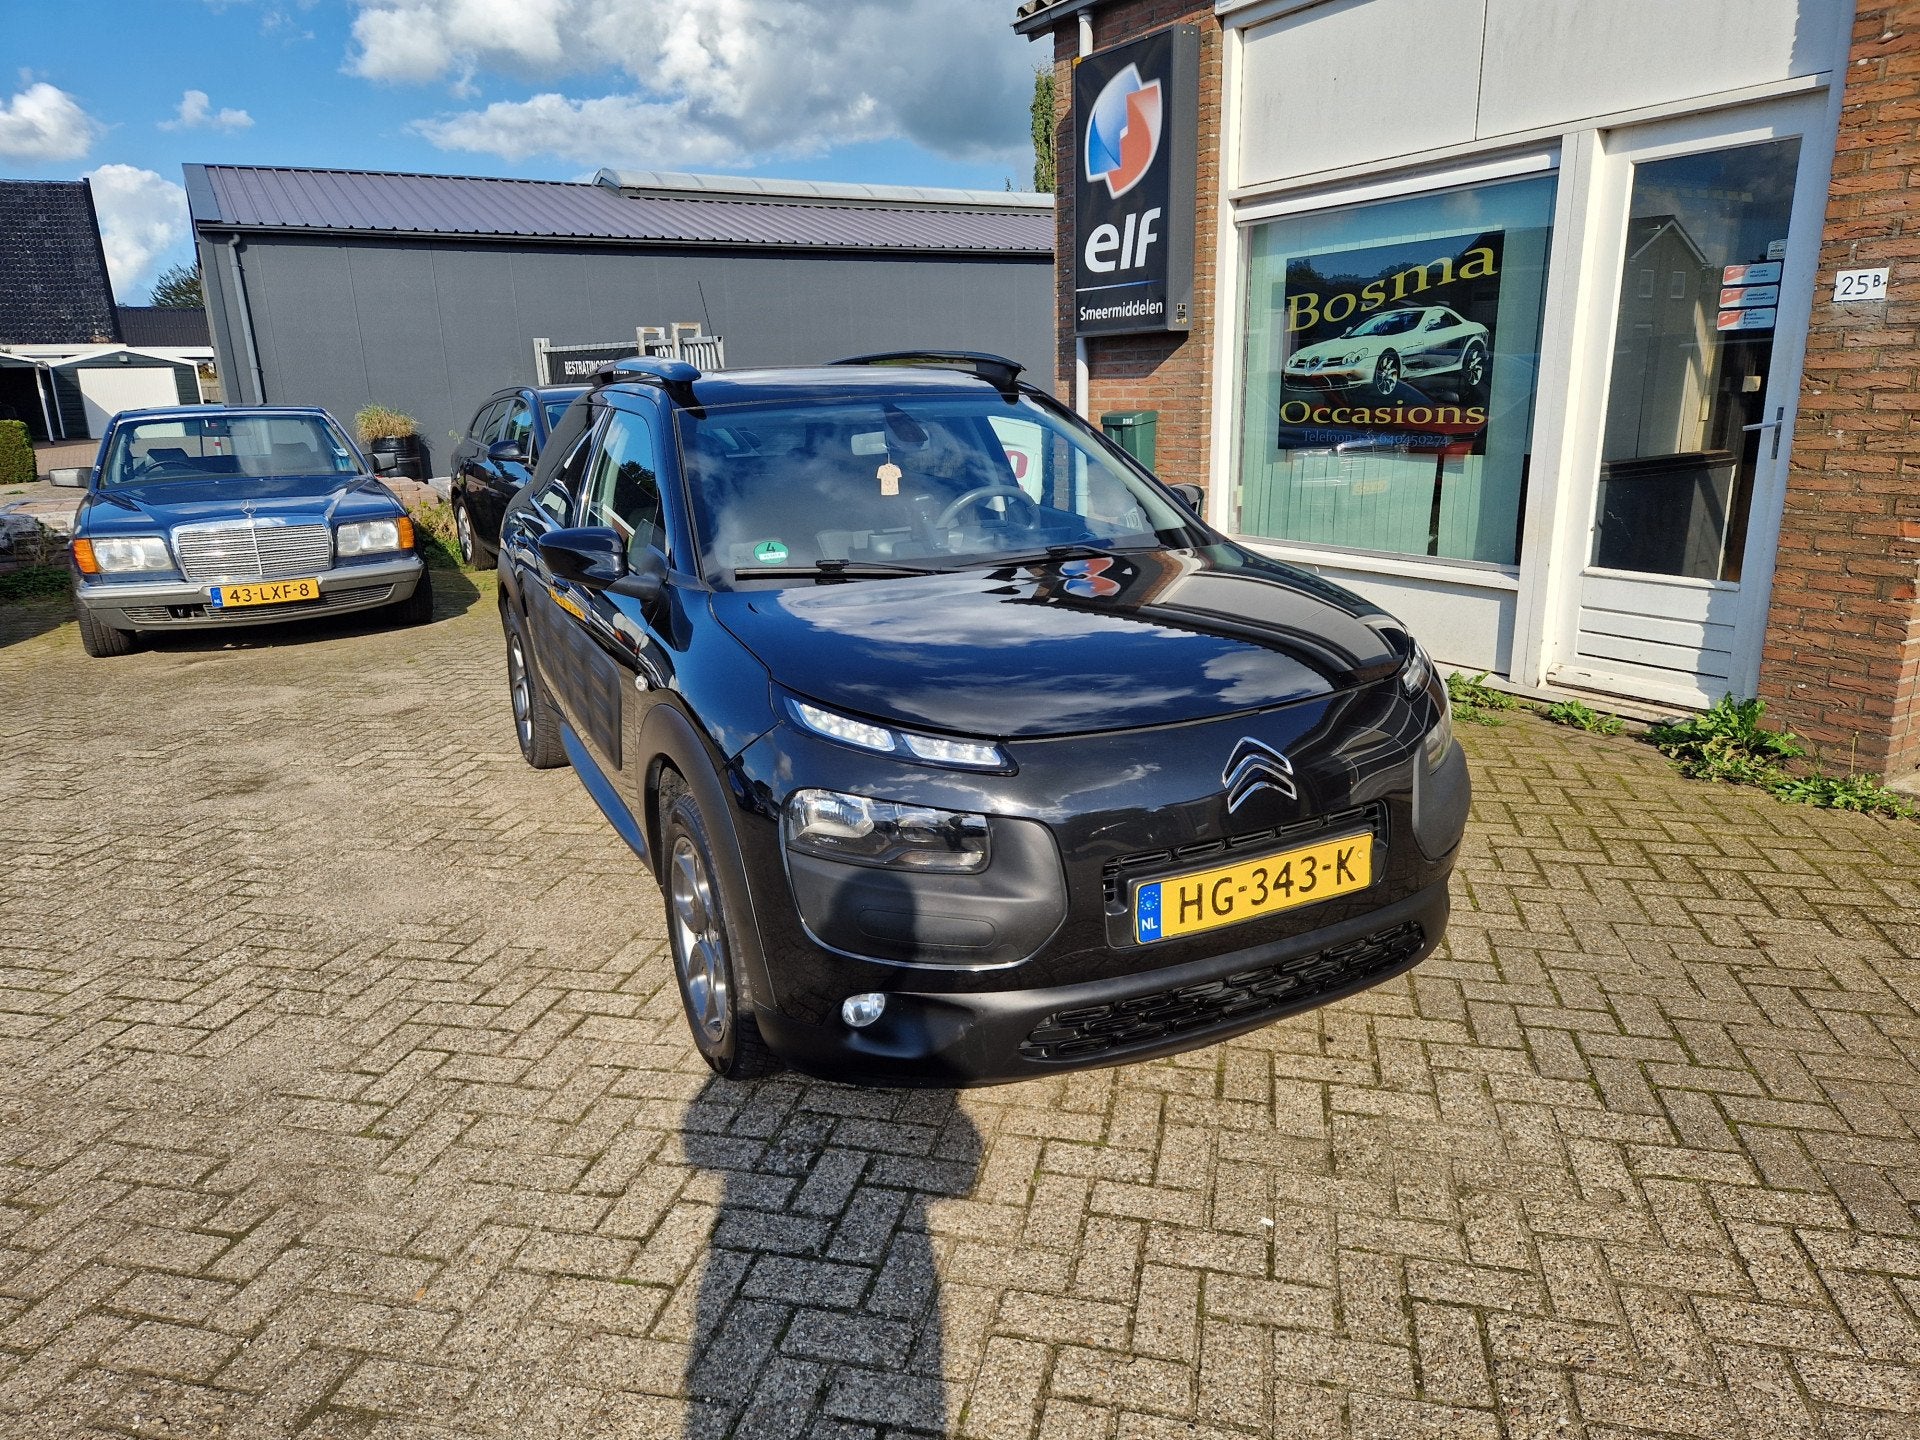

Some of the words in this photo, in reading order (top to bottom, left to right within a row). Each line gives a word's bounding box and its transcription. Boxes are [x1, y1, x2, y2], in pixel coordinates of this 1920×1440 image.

[1085, 207, 1161, 273] elf
[1285, 247, 1498, 333] Bosma
[1080, 299, 1163, 320] Smeermiddelen
[1280, 400, 1487, 425] Occasions
[1302, 430, 1351, 443] Telefoon
[766, 542, 776, 552] 4
[229, 583, 309, 603] 43-LXF-8
[1141, 917, 1158, 931] NL
[1179, 846, 1356, 924] HG-343-K
